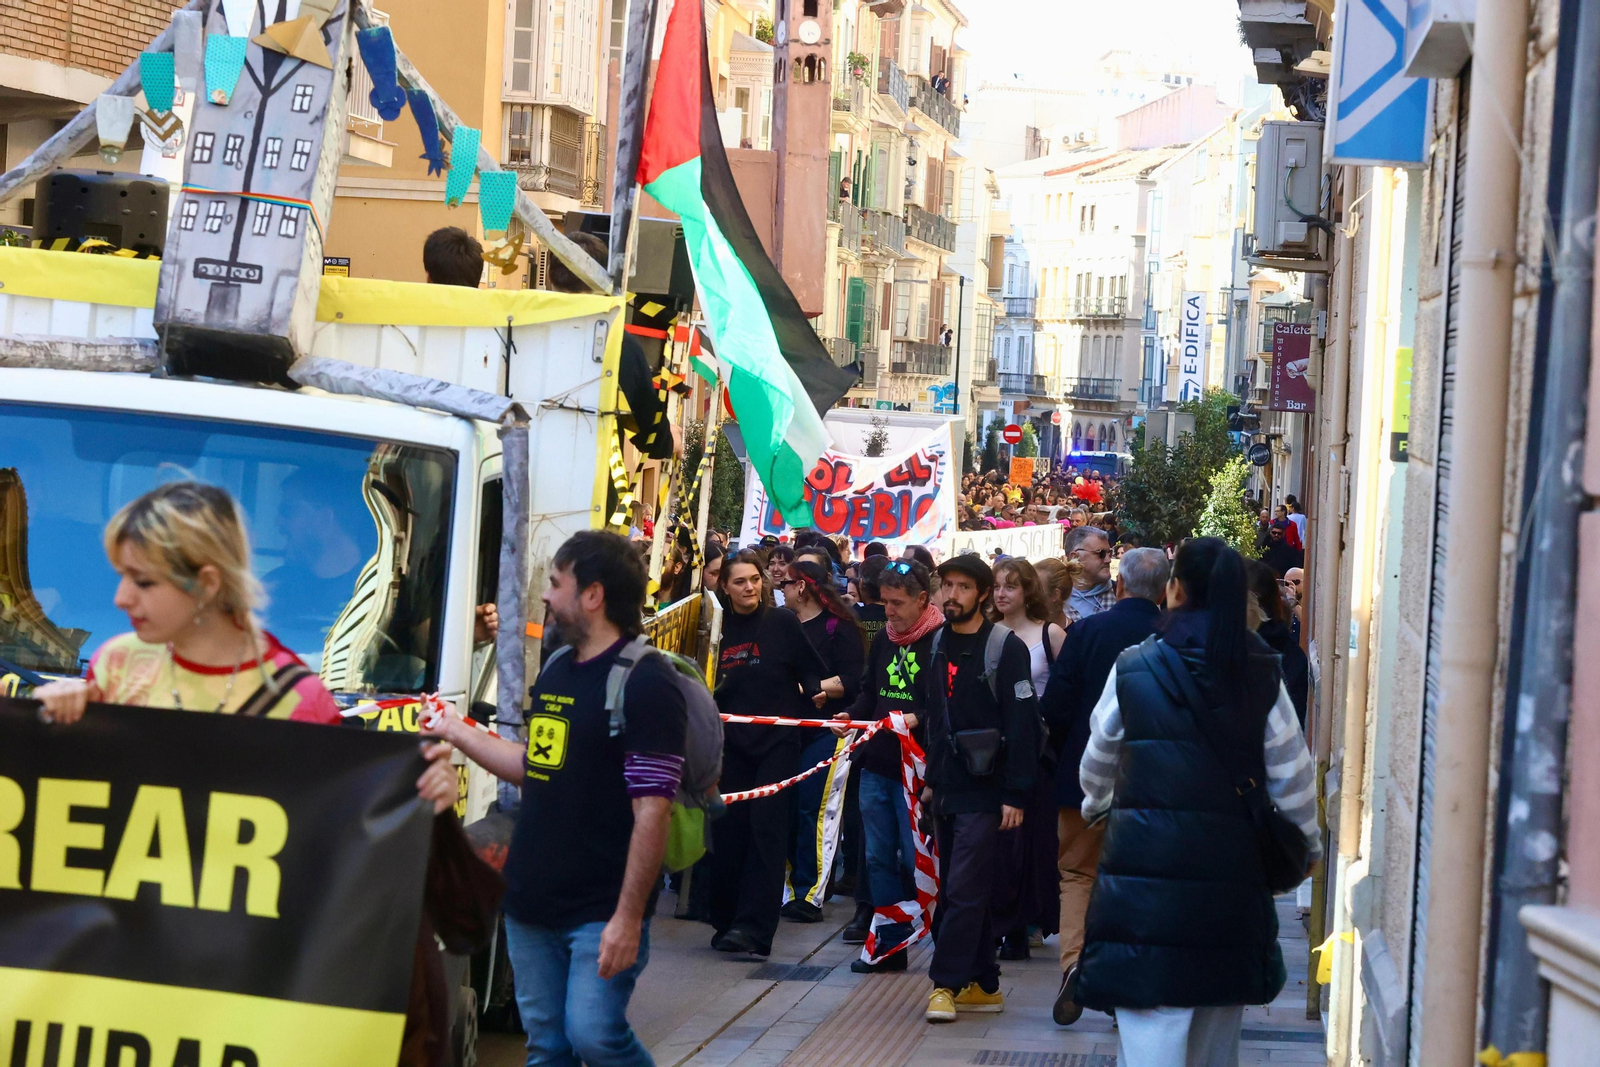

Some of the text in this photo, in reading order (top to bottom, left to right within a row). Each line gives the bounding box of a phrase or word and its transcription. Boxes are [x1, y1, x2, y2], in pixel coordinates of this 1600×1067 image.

[1184, 295, 1200, 375] E-DIFICA
[1286, 400, 1307, 410] Bar
[1019, 528, 1061, 559] SIGUE
